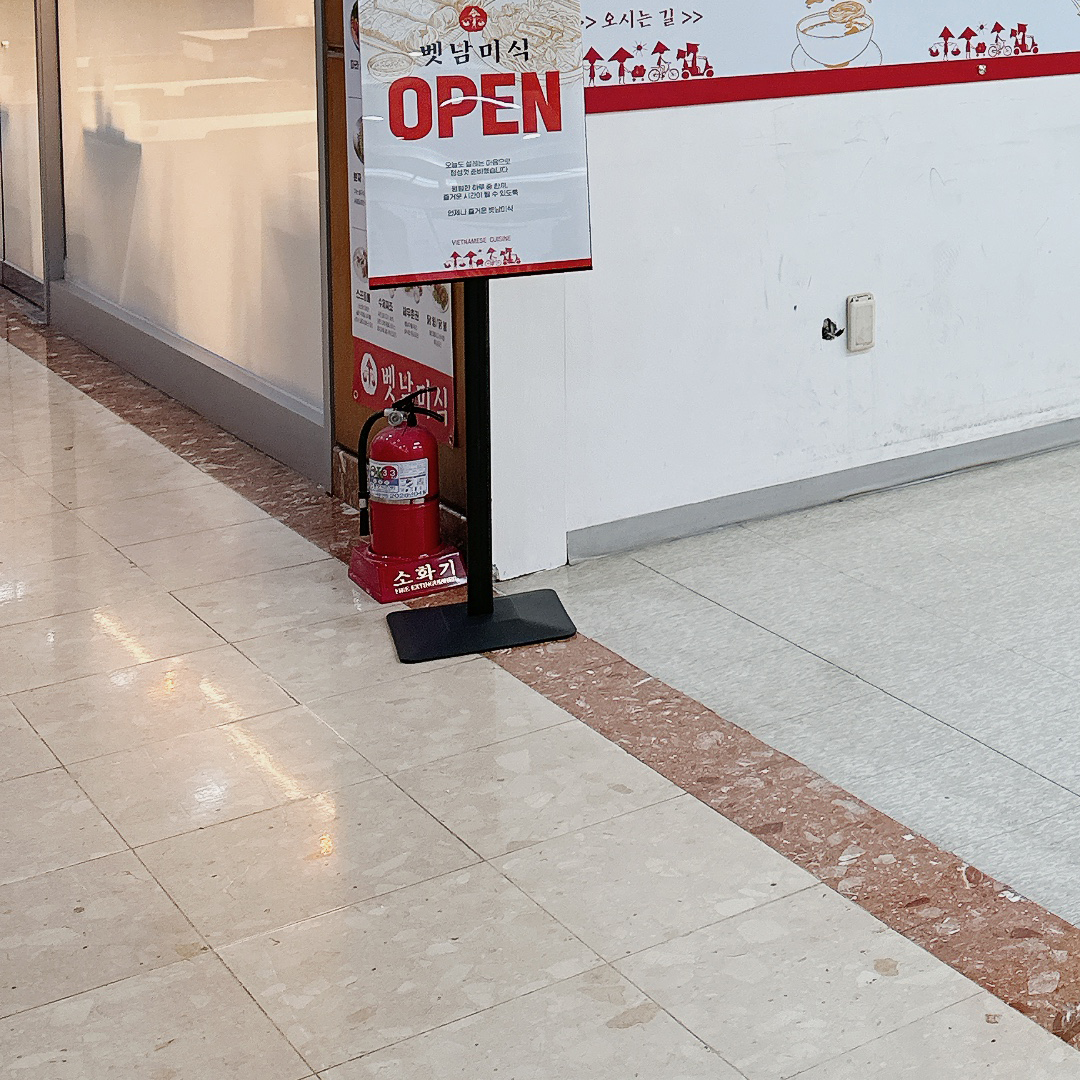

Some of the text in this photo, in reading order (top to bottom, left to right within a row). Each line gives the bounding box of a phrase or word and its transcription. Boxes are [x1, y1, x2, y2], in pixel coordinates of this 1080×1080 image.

[602, 8, 675, 28] 오시는 길
[420, 38, 529, 66] 벳남미식
[388, 70, 562, 140] OPEN
[452, 235, 511, 245] VIETNAMESE CUISINE
[381, 364, 448, 426] 벳남미식
[393, 559, 456, 587] 소화기
